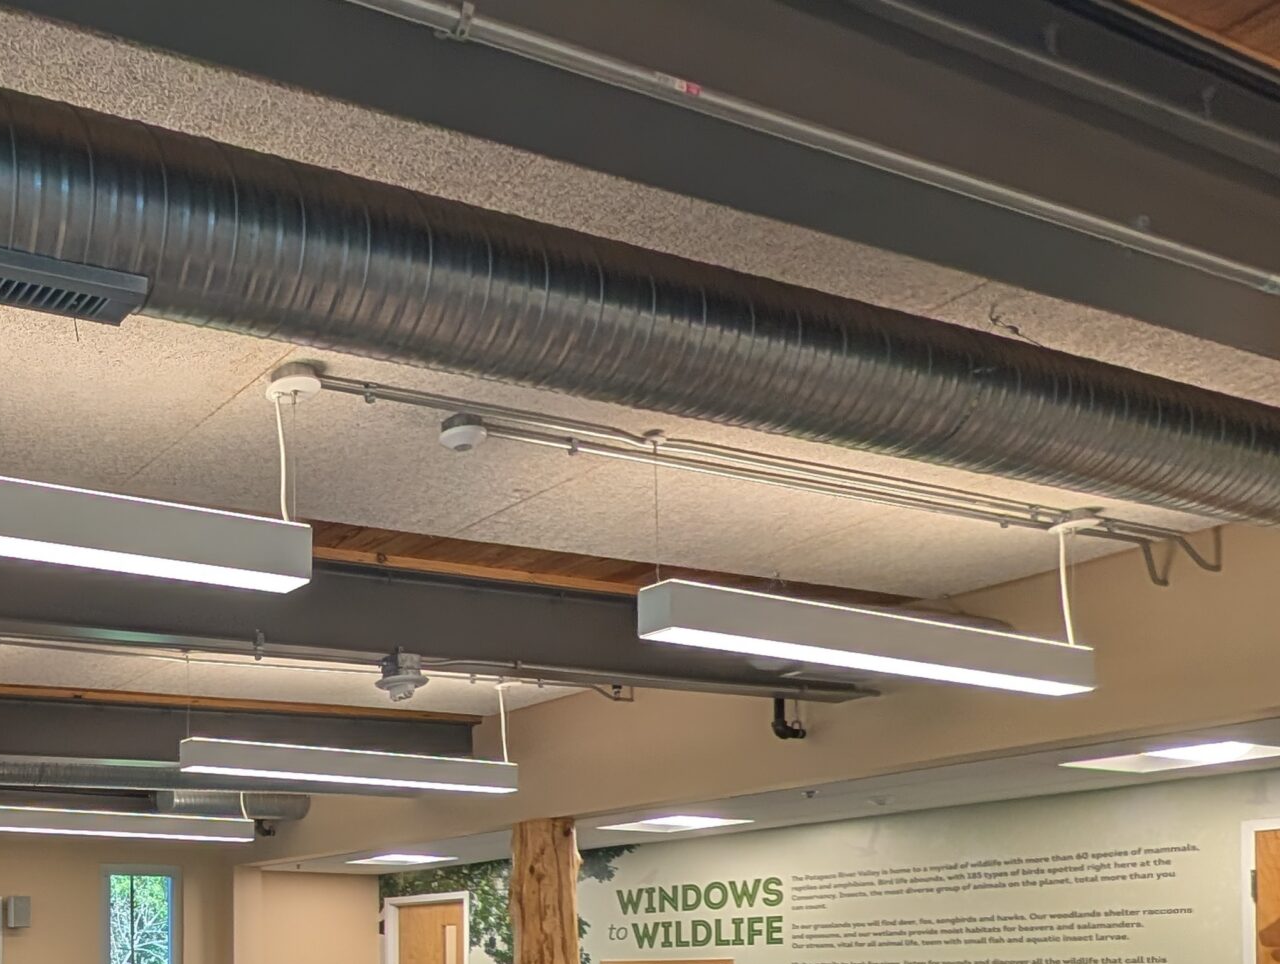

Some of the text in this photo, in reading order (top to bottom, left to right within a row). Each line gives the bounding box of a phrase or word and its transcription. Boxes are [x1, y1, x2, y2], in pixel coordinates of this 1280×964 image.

[616, 877, 784, 915] WINDOWS
[608, 915, 784, 949] to WILDLIFE
